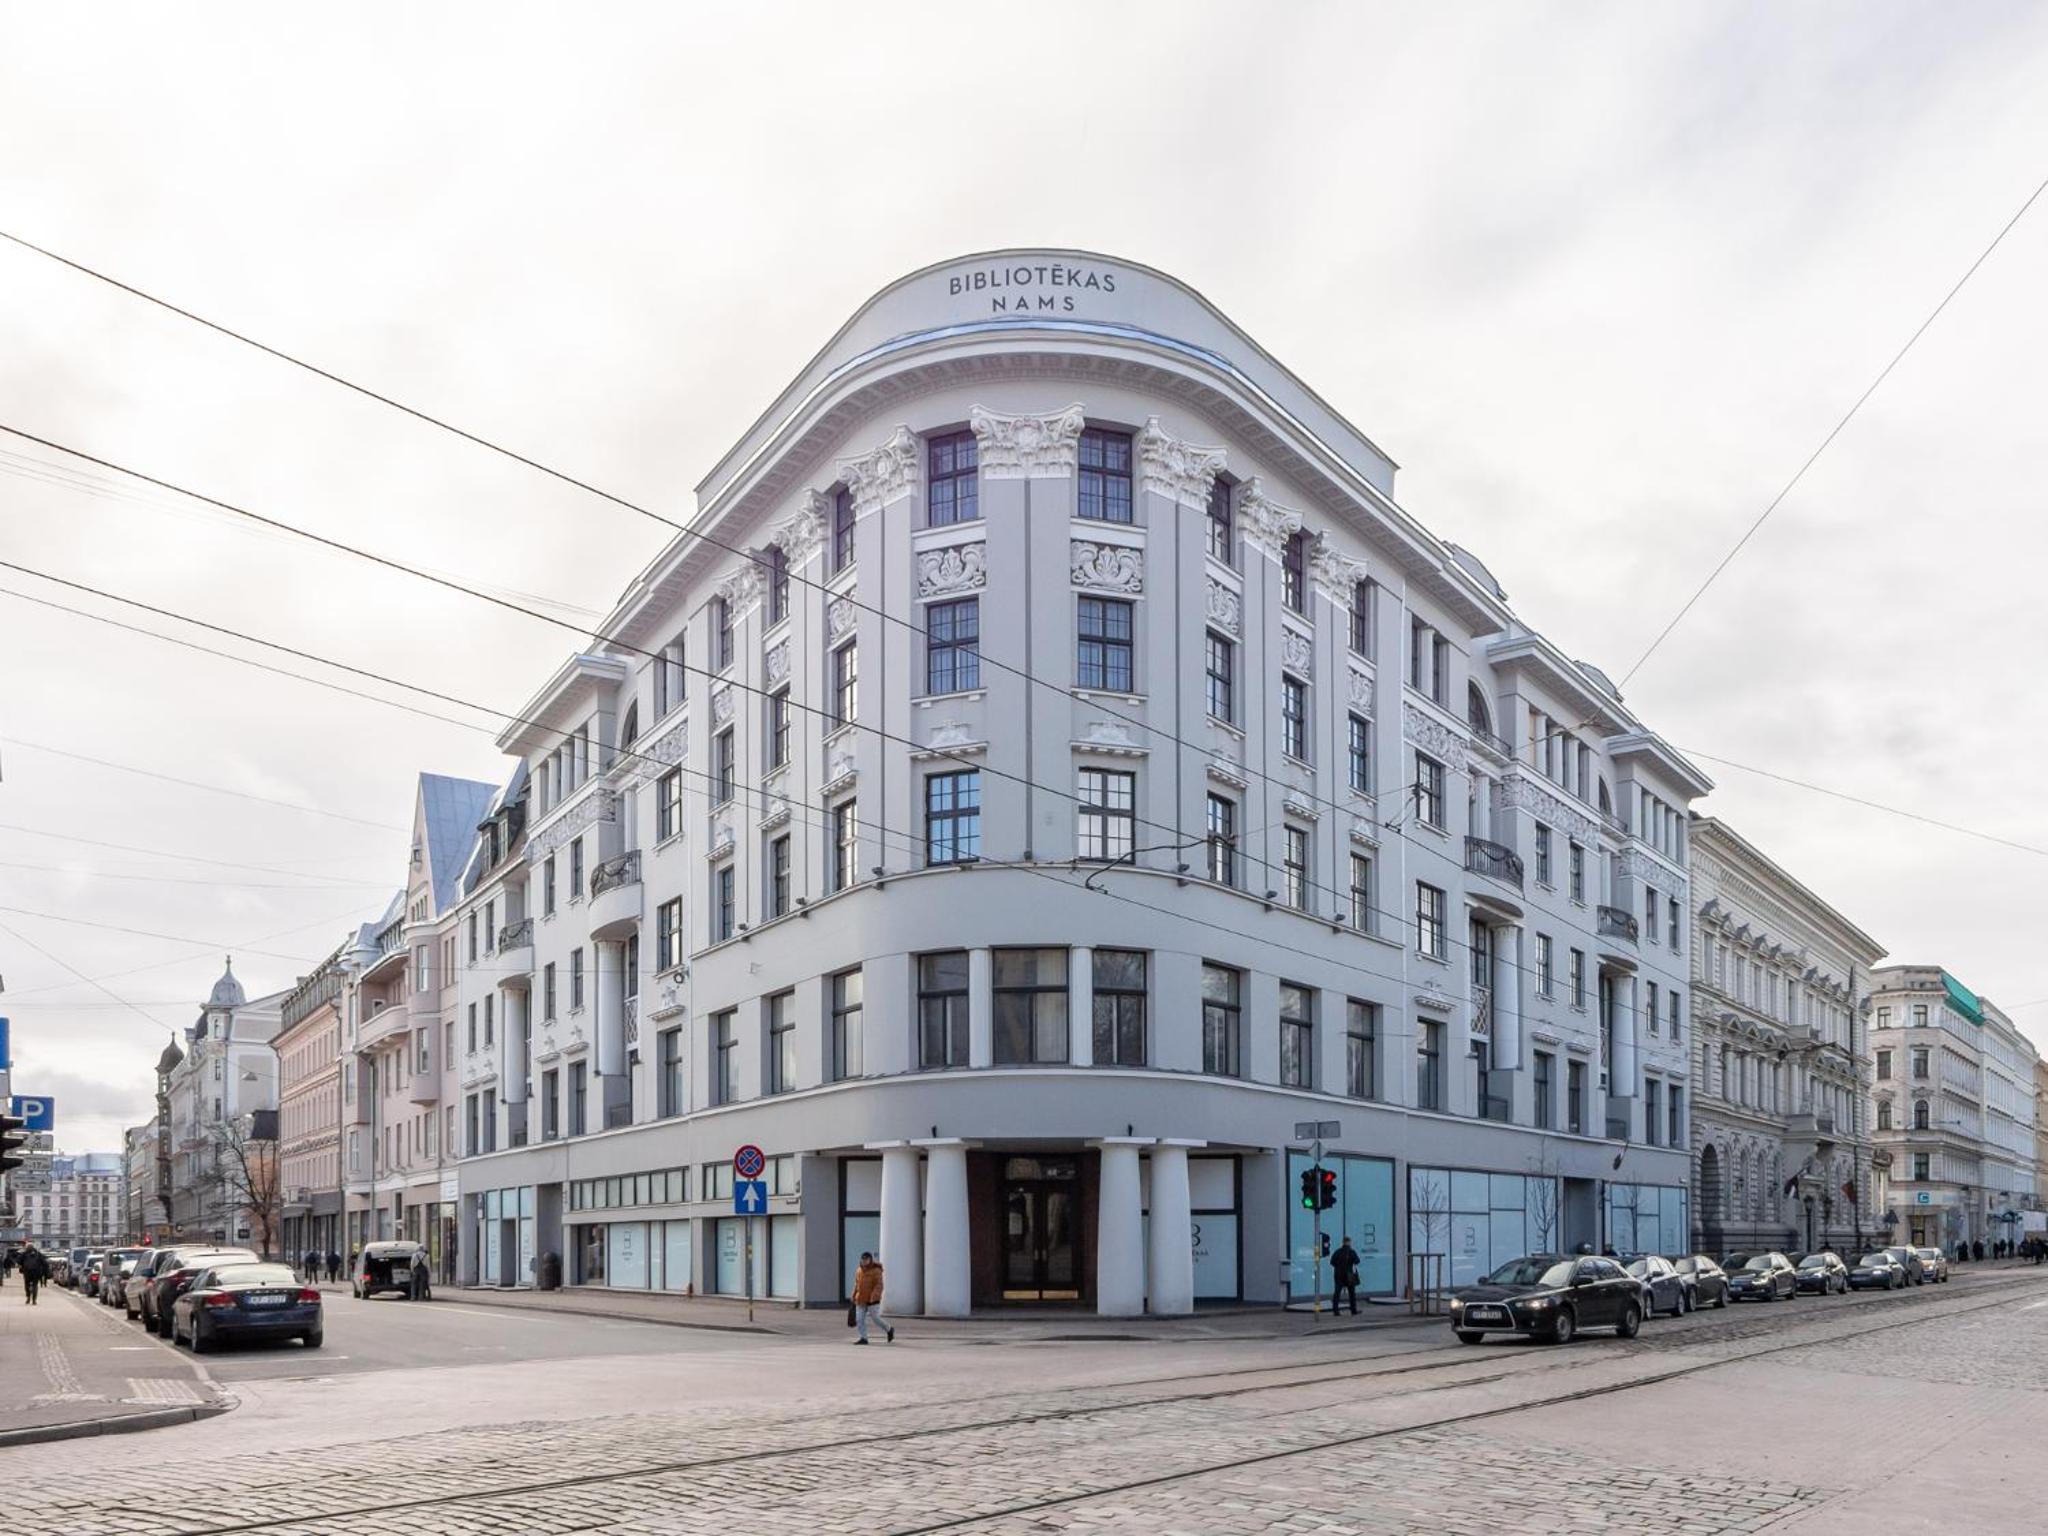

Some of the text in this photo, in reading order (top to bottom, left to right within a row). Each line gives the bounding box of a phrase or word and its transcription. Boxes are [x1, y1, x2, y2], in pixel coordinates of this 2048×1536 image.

[949, 264, 1116, 296] BIBLIOTĒKAS
[992, 296, 1075, 312] NAMS
[21, 1100, 44, 1126] P
